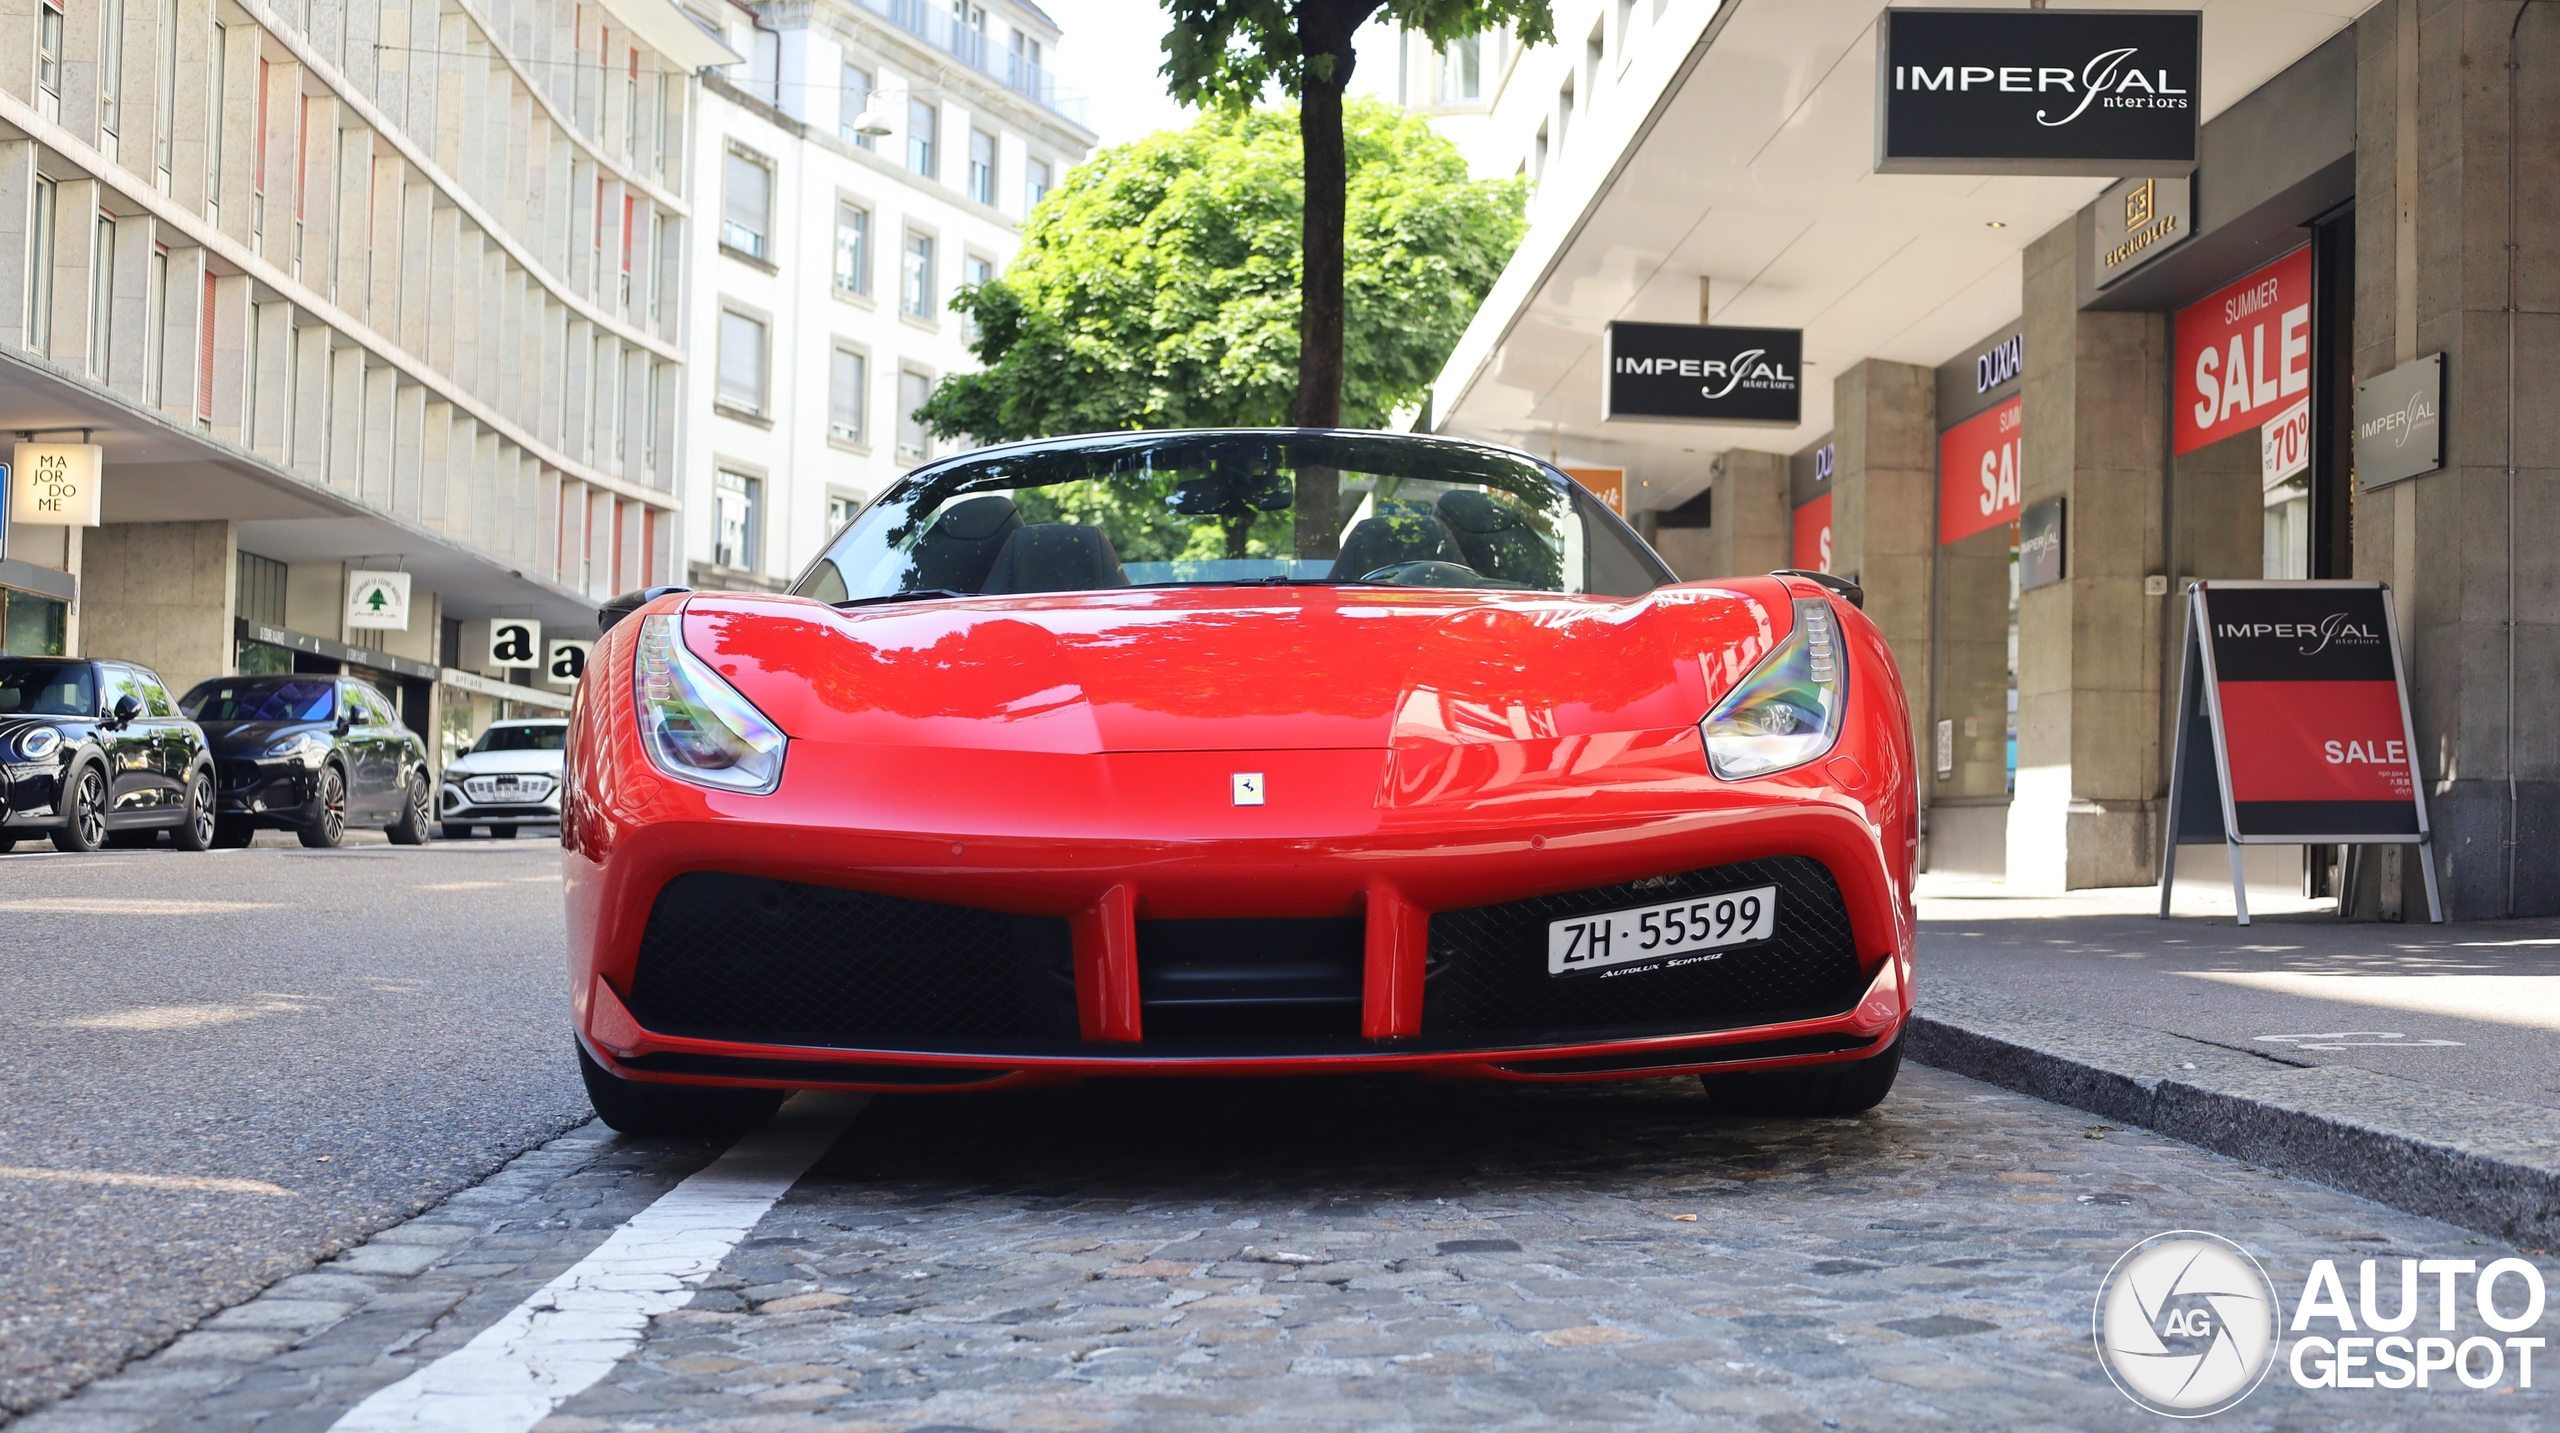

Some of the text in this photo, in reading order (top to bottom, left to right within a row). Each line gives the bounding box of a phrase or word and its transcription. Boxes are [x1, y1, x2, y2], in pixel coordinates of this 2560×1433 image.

[2225, 277, 2278, 325] SUMMER
[2194, 303, 2309, 430] SALE
[41, 455, 67, 468] MA
[2265, 458, 2273, 471] TO
[33, 469, 64, 486] JOR
[49, 484, 76, 497] DO
[38, 498, 62, 512] ME
[494, 625, 534, 661] a
[552, 645, 585, 678] a
[2324, 740, 2406, 764] SALE
[1563, 919, 1611, 964] ZH
[1640, 895, 1761, 949] 55599
